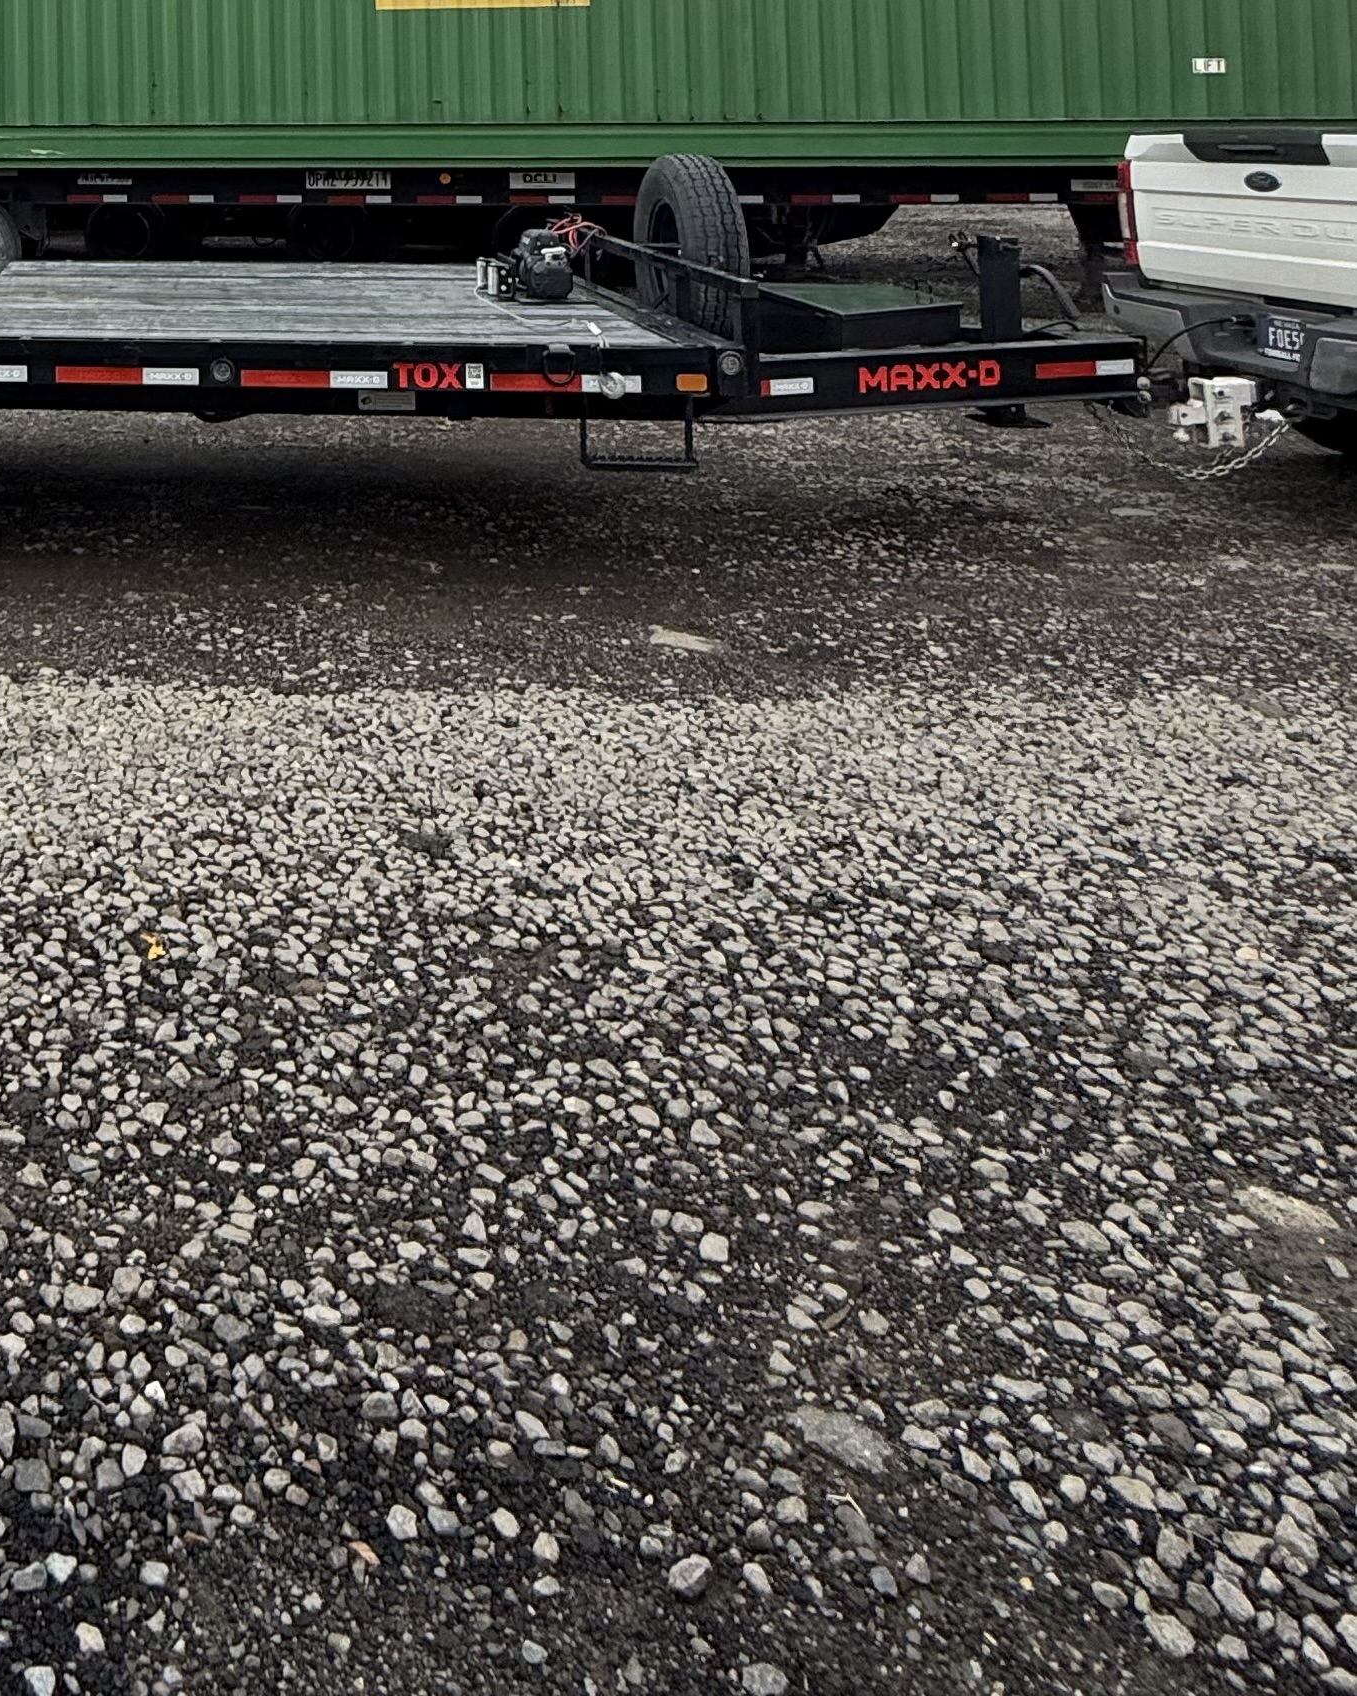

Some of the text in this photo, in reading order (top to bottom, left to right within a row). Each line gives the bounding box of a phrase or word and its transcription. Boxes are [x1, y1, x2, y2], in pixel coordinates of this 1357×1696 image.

[1193, 58, 1224, 73] LIFT
[394, 362, 463, 389] TOX
[858, 360, 1000, 393] MAXX-D
